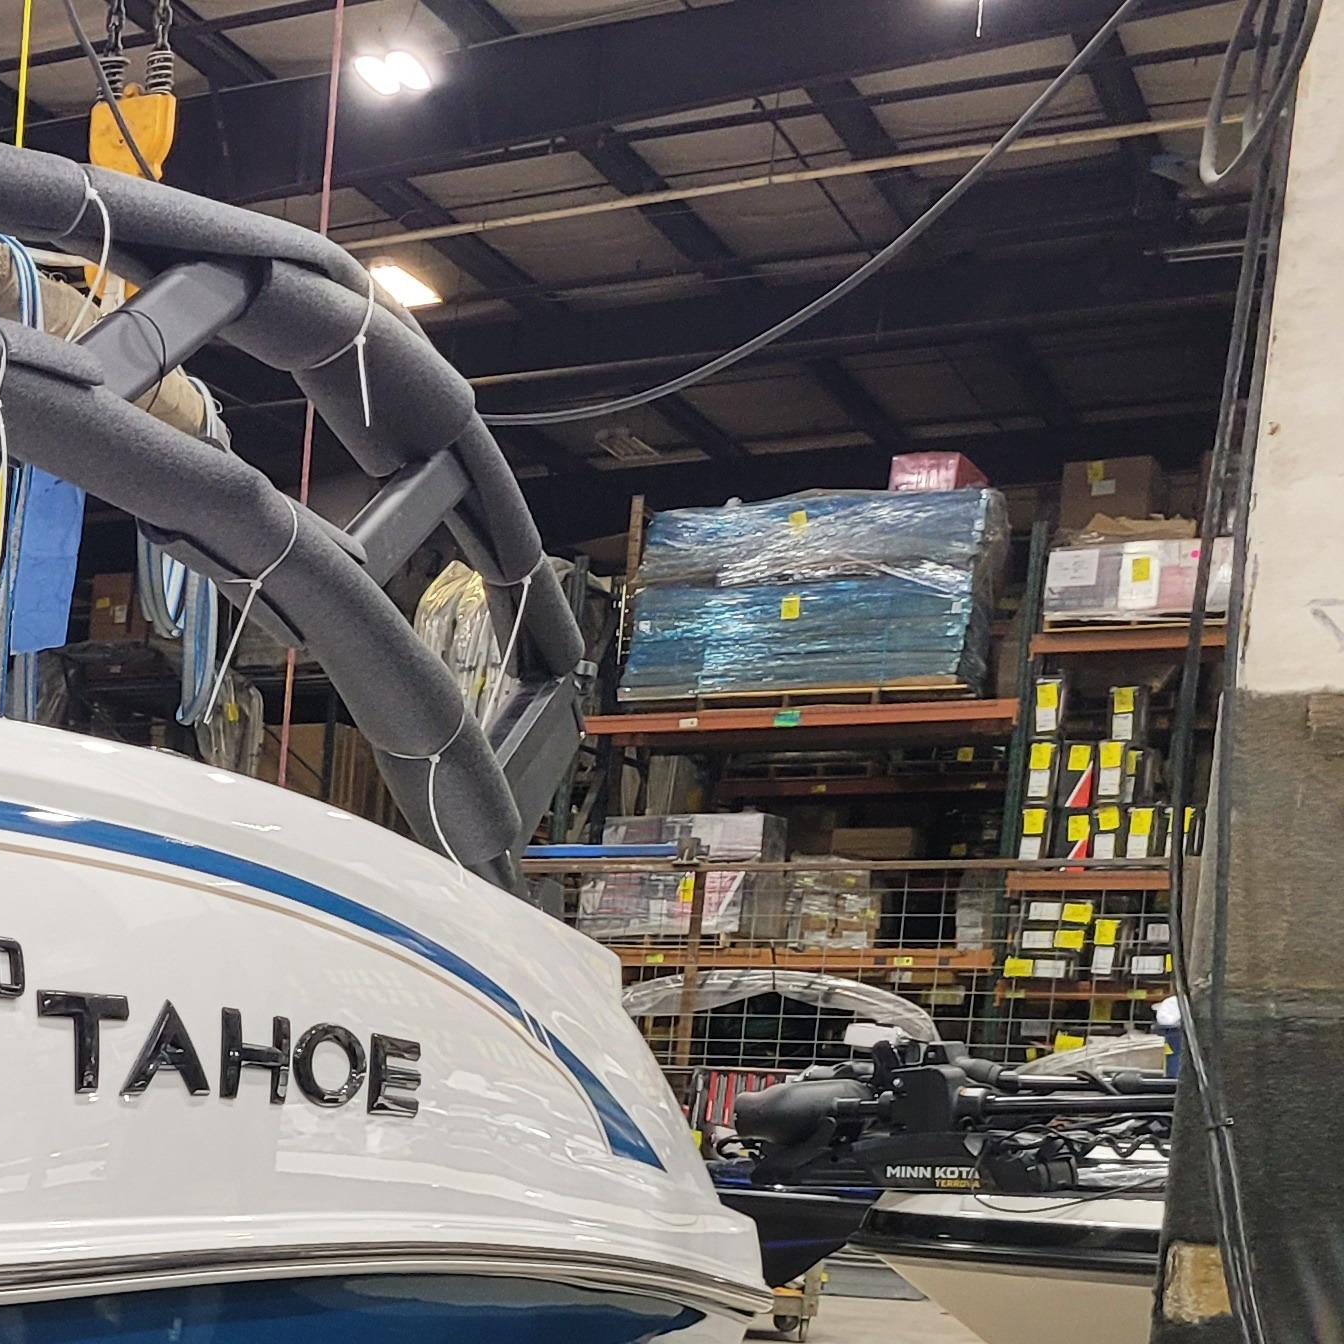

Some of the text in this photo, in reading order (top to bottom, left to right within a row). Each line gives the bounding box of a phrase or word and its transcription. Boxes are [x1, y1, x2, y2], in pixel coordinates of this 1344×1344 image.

[37, 989, 422, 1119] TAHOE
[886, 1165, 980, 1179] MINN KOTA
